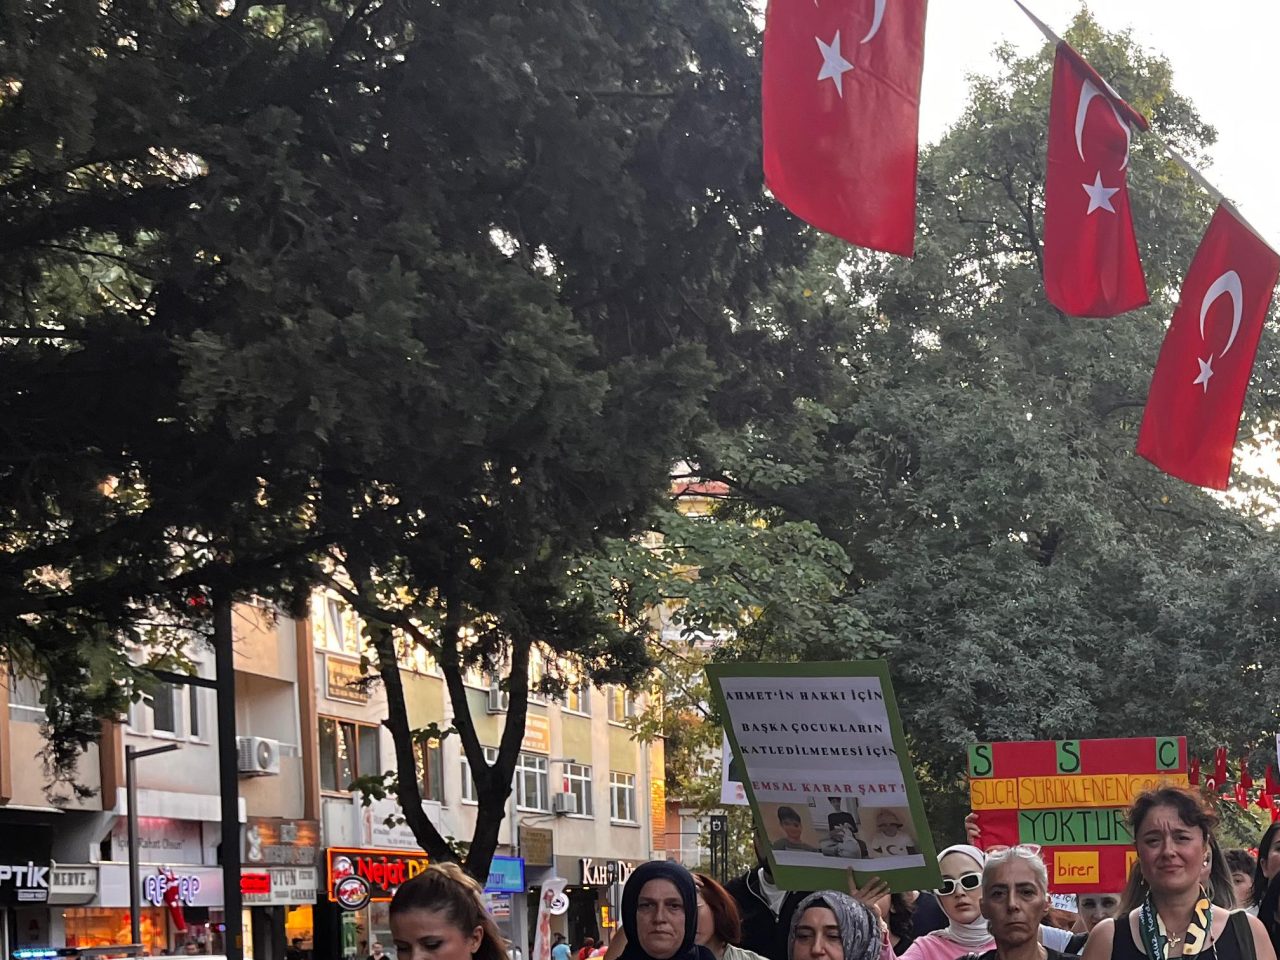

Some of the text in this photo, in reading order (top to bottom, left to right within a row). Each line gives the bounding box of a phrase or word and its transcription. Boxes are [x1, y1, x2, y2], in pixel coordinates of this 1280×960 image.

[800, 691, 846, 701] HAKKI
[852, 689, 883, 703] İÇİN
[742, 723, 883, 734] BAŞKA ÇOCUKLARIN
[741, 744, 864, 756] KATLEDİLMEMESİ
[974, 745, 992, 776] S
[1059, 742, 1080, 773] S
[753, 781, 797, 792] EMSAL
[802, 783, 853, 793] KARAR
[858, 783, 894, 795] ŞART
[972, 780, 1015, 806] SUÇA
[1020, 809, 1133, 843] YOKTUR
[357, 856, 405, 890] Nejat
[1058, 856, 1094, 877] birer
